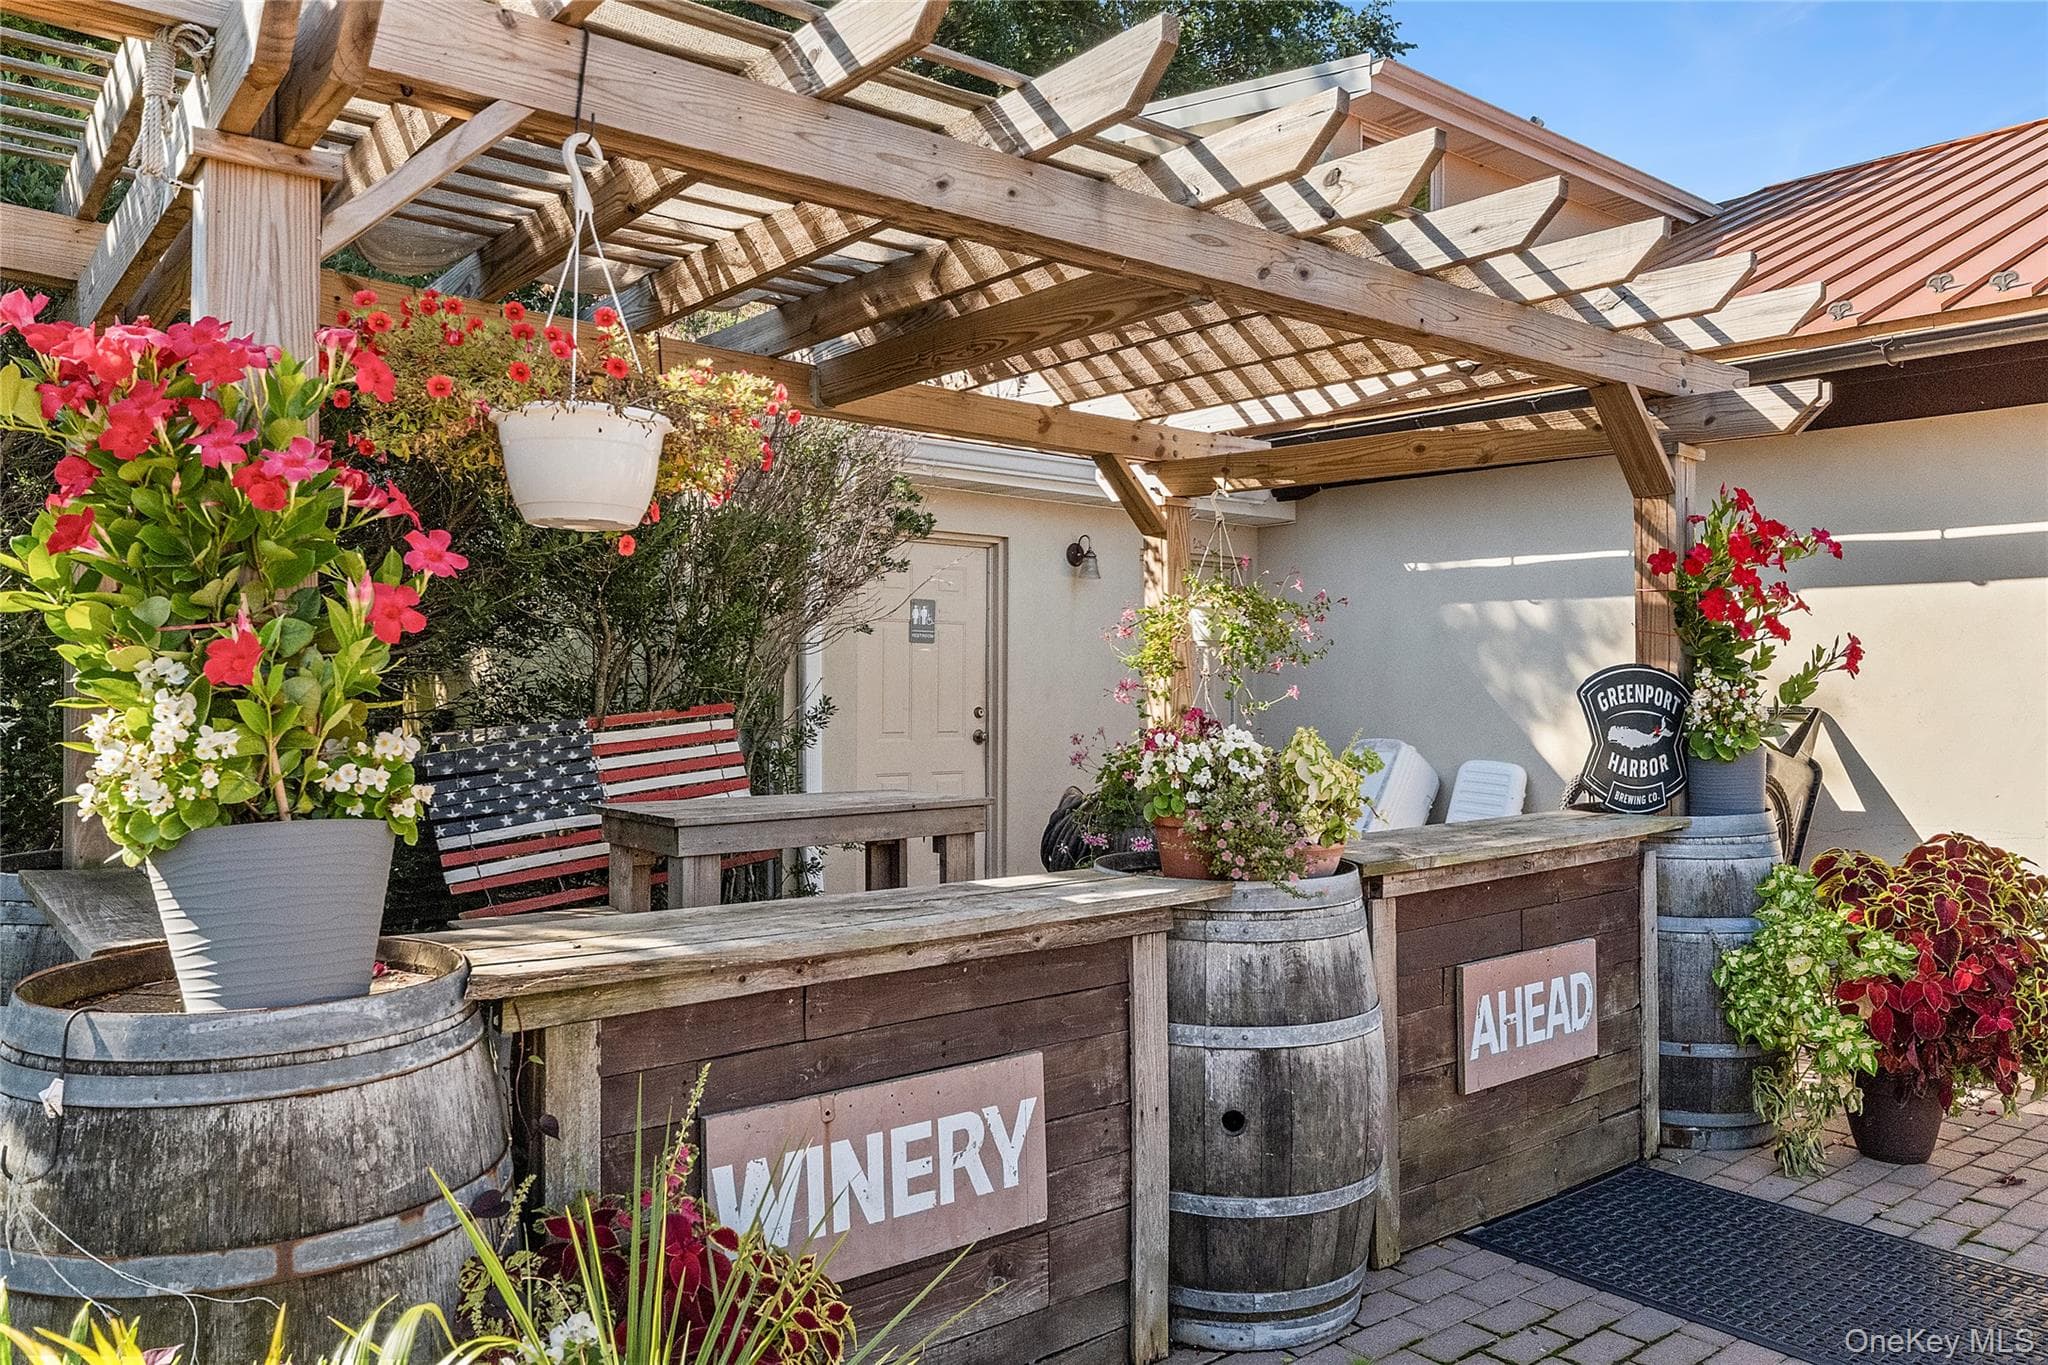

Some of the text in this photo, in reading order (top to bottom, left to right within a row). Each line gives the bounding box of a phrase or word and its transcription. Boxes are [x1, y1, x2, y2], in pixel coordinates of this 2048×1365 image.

[1597, 684, 1681, 714] GREENPORT
[1607, 752, 1669, 778] HARBOR
[1614, 791, 1661, 805] BREWING CO.
[1470, 971, 1594, 1061] AHEAD
[711, 1096, 1038, 1261] WINERY
